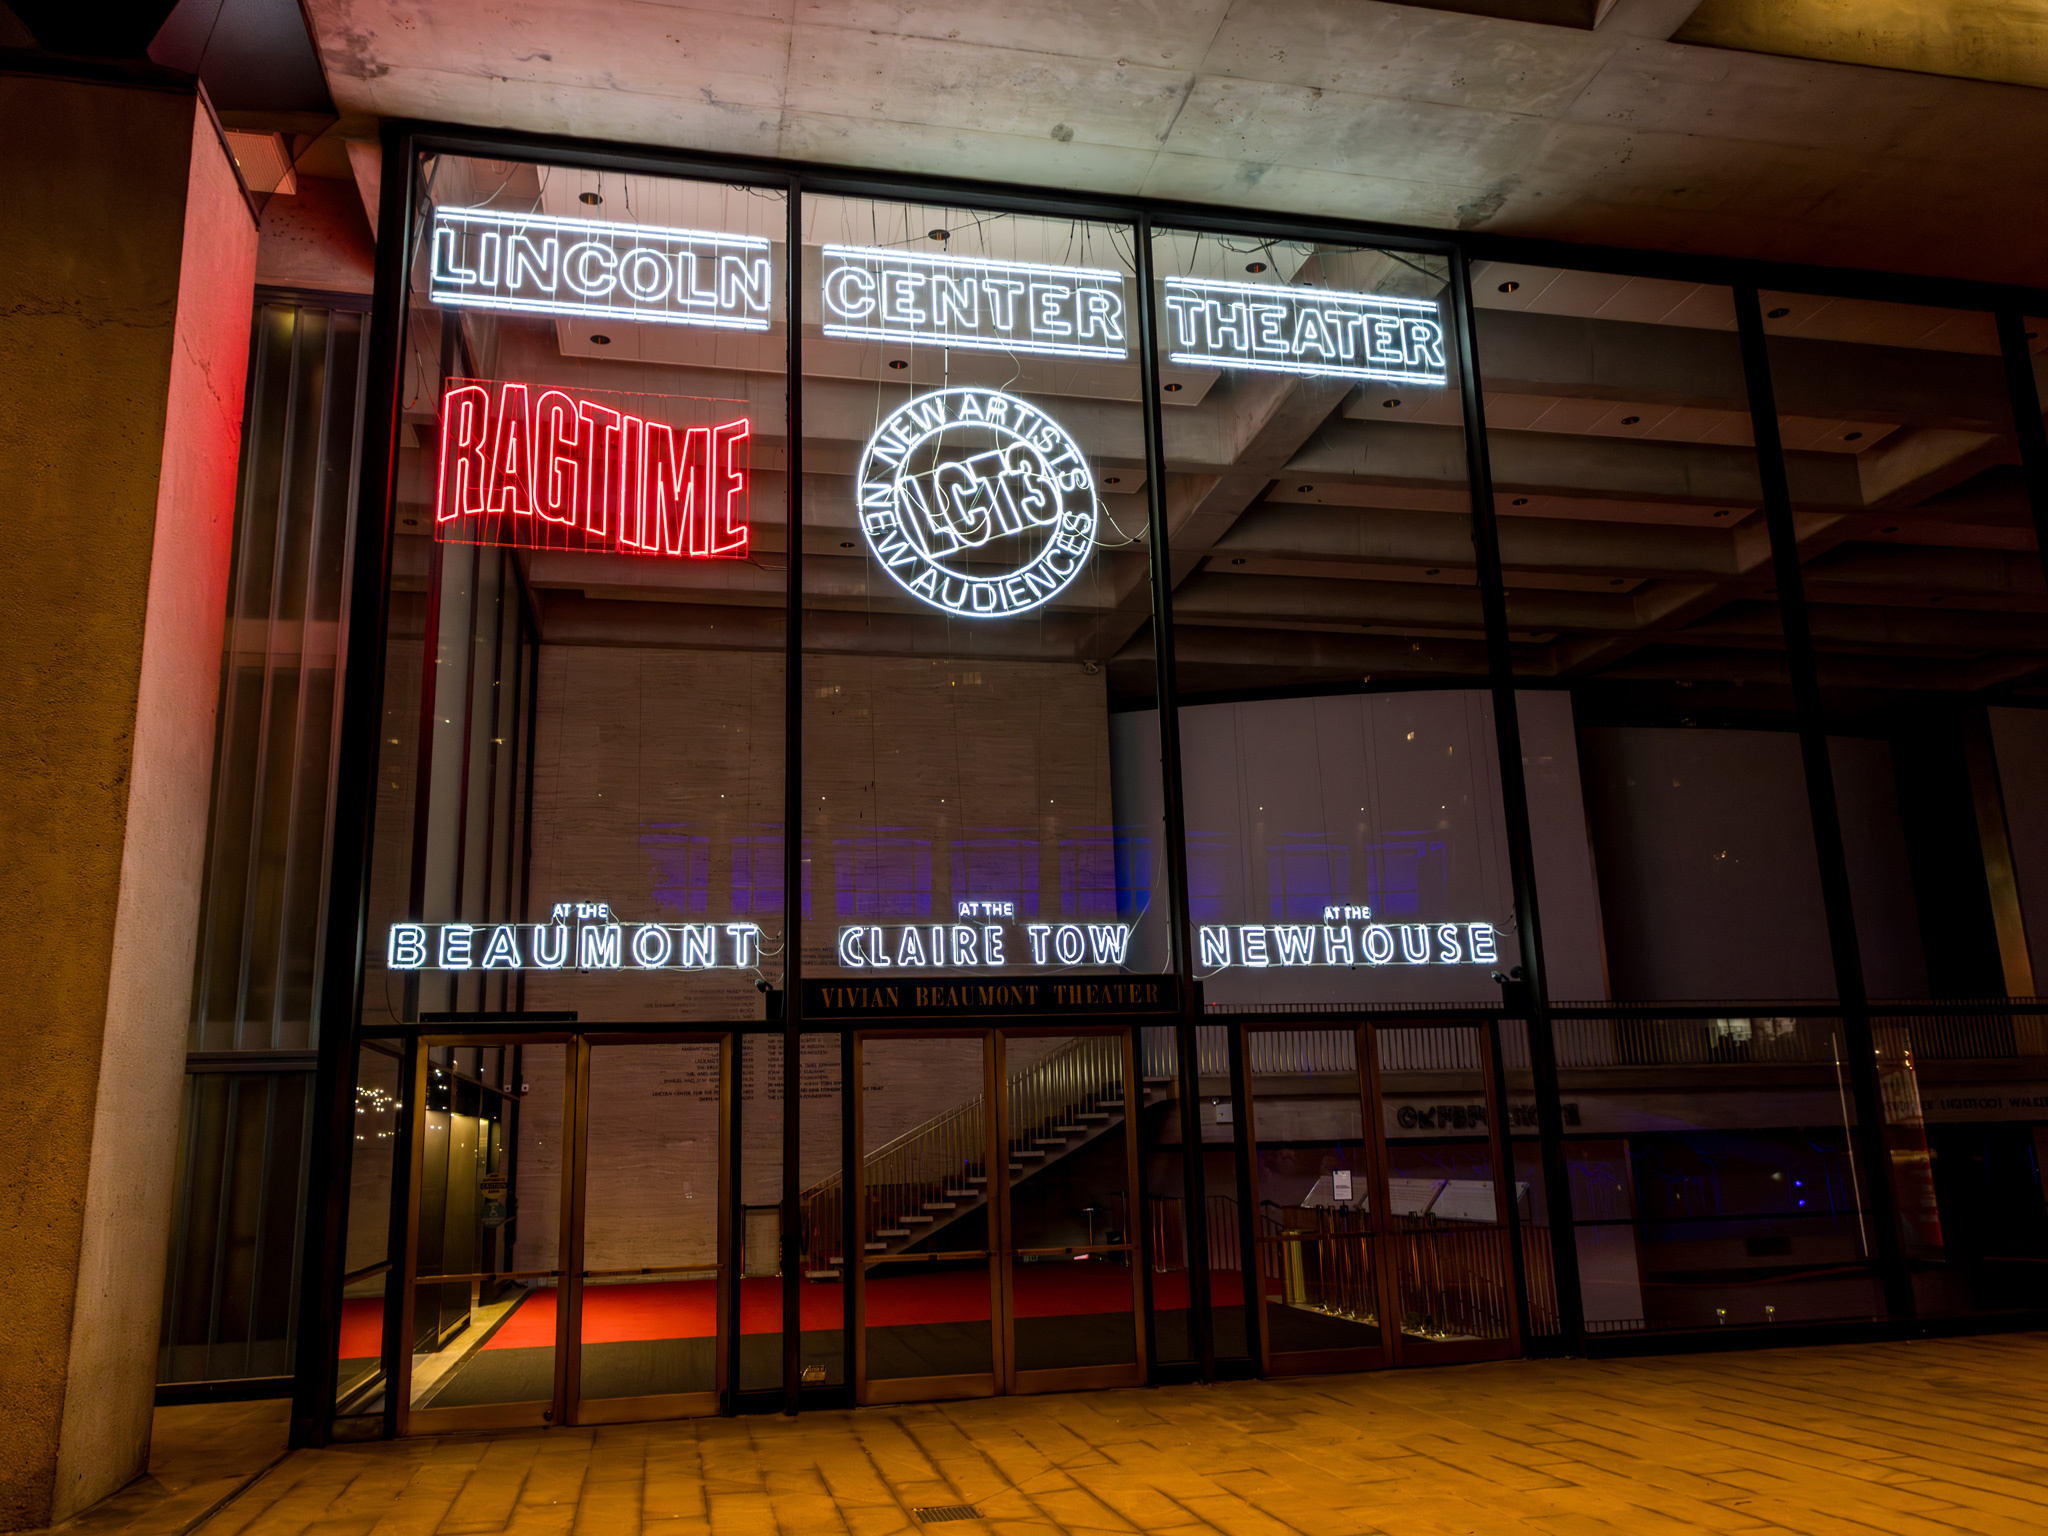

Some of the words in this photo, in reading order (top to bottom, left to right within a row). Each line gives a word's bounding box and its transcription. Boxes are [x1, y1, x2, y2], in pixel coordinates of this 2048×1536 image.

[432, 227, 769, 311] LINCOLN
[824, 266, 1125, 340] CENTER
[1166, 296, 1445, 367] THEATER
[873, 397, 946, 466] NEW
[958, 394, 1090, 492] ARTISTS
[437, 383, 749, 555] RAGTIME
[899, 441, 1061, 559] LCT3
[862, 483, 918, 567] NEW
[909, 511, 1092, 611] AUDIENCES
[553, 903, 572, 918] AT
[576, 903, 608, 918] THE
[960, 903, 980, 916] AT
[982, 902, 1013, 916] THE
[1324, 906, 1341, 920] AT
[1344, 906, 1371, 920] THE
[388, 924, 758, 969] BEAUMONT
[840, 925, 1005, 967] CLAIRE
[1028, 924, 1130, 965] TOW
[1200, 924, 1498, 967] NEWHOUSE
[821, 987, 900, 1009] VIVIAN
[916, 985, 1039, 1007] BEAUMONT
[1054, 983, 1160, 1006] THEATER
